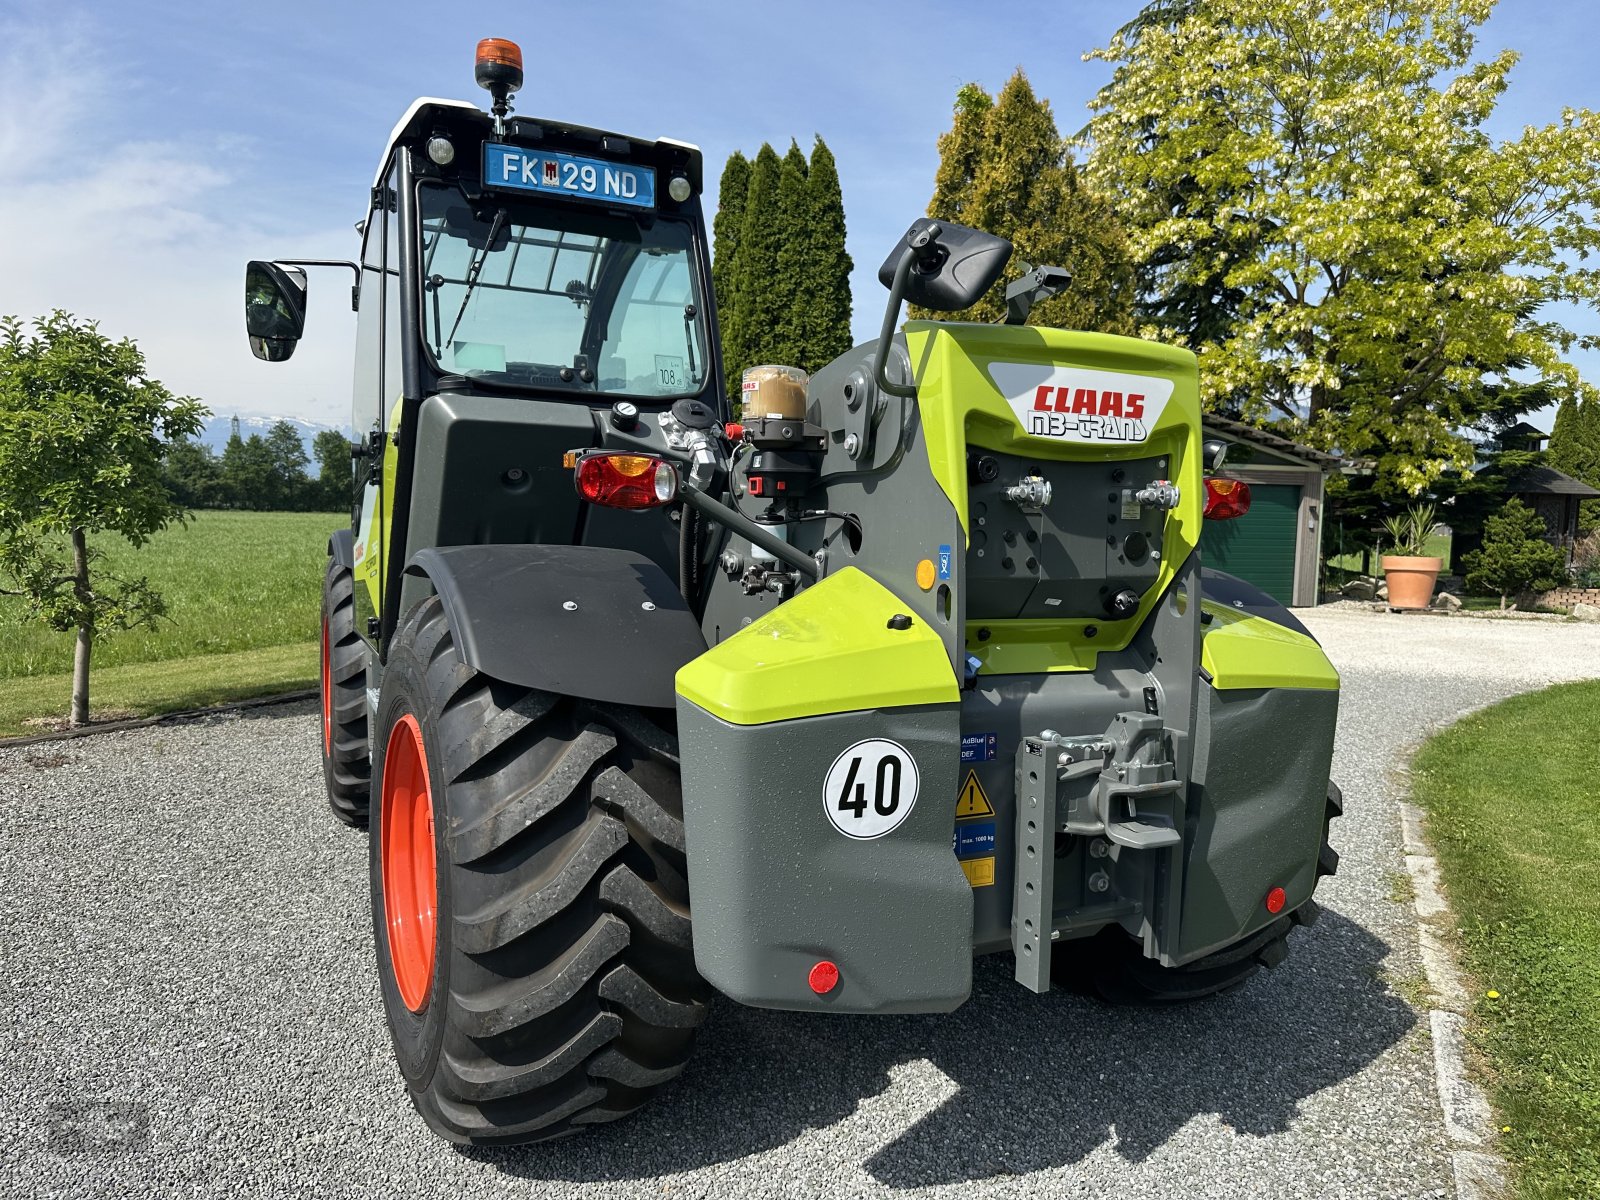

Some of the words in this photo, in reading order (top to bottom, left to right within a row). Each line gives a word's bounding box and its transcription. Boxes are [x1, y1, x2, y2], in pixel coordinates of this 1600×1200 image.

[503, 153, 538, 185] FK
[563, 163, 597, 192] 29
[604, 168, 637, 199] ND
[660, 369, 675, 385] 108
[1033, 385, 1145, 419] CLAAS
[961, 750, 974, 758] DEF
[838, 754, 902, 818] 40
